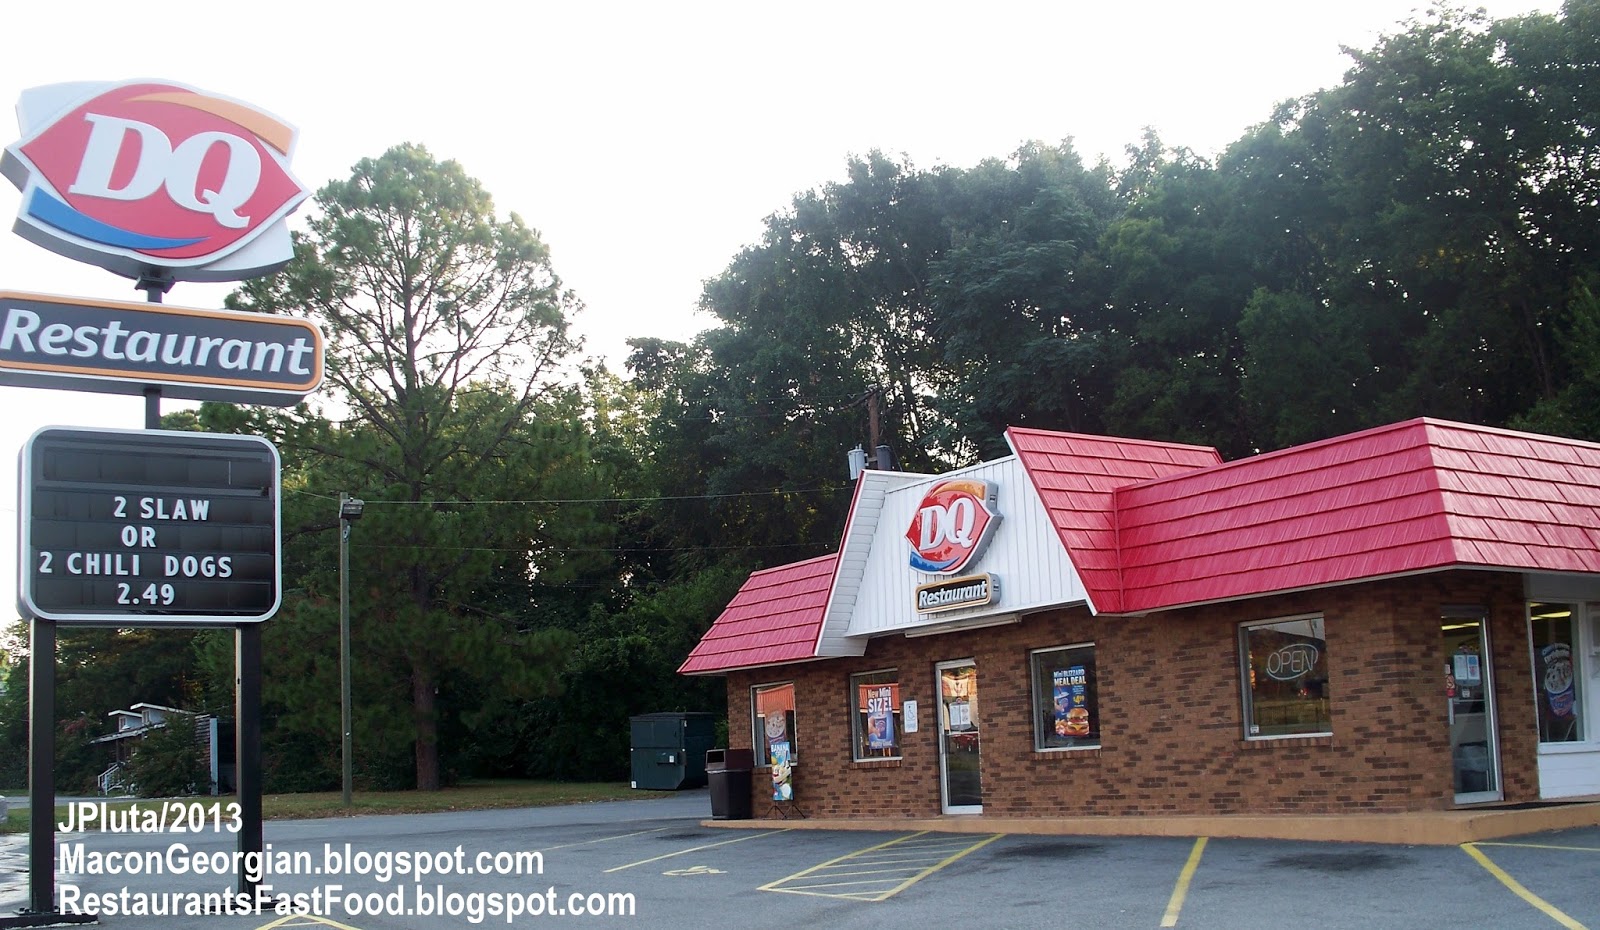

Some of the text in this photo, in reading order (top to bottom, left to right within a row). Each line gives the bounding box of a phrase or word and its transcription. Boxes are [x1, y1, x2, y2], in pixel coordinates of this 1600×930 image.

[68, 112, 262, 229] DQ
[0, 308, 315, 375] Restaurant
[114, 496, 210, 521] 2 SLAW
[918, 497, 976, 549] DQ
[121, 525, 156, 548] OR
[39, 551, 233, 578] 2 CHILI DOGS
[117, 582, 175, 606] 2.49
[918, 579, 988, 608] Restaurant
[1267, 650, 1314, 673] OPEN
[1054, 675, 1087, 687] MEAL DEAL
[867, 696, 892, 713] SIZE!
